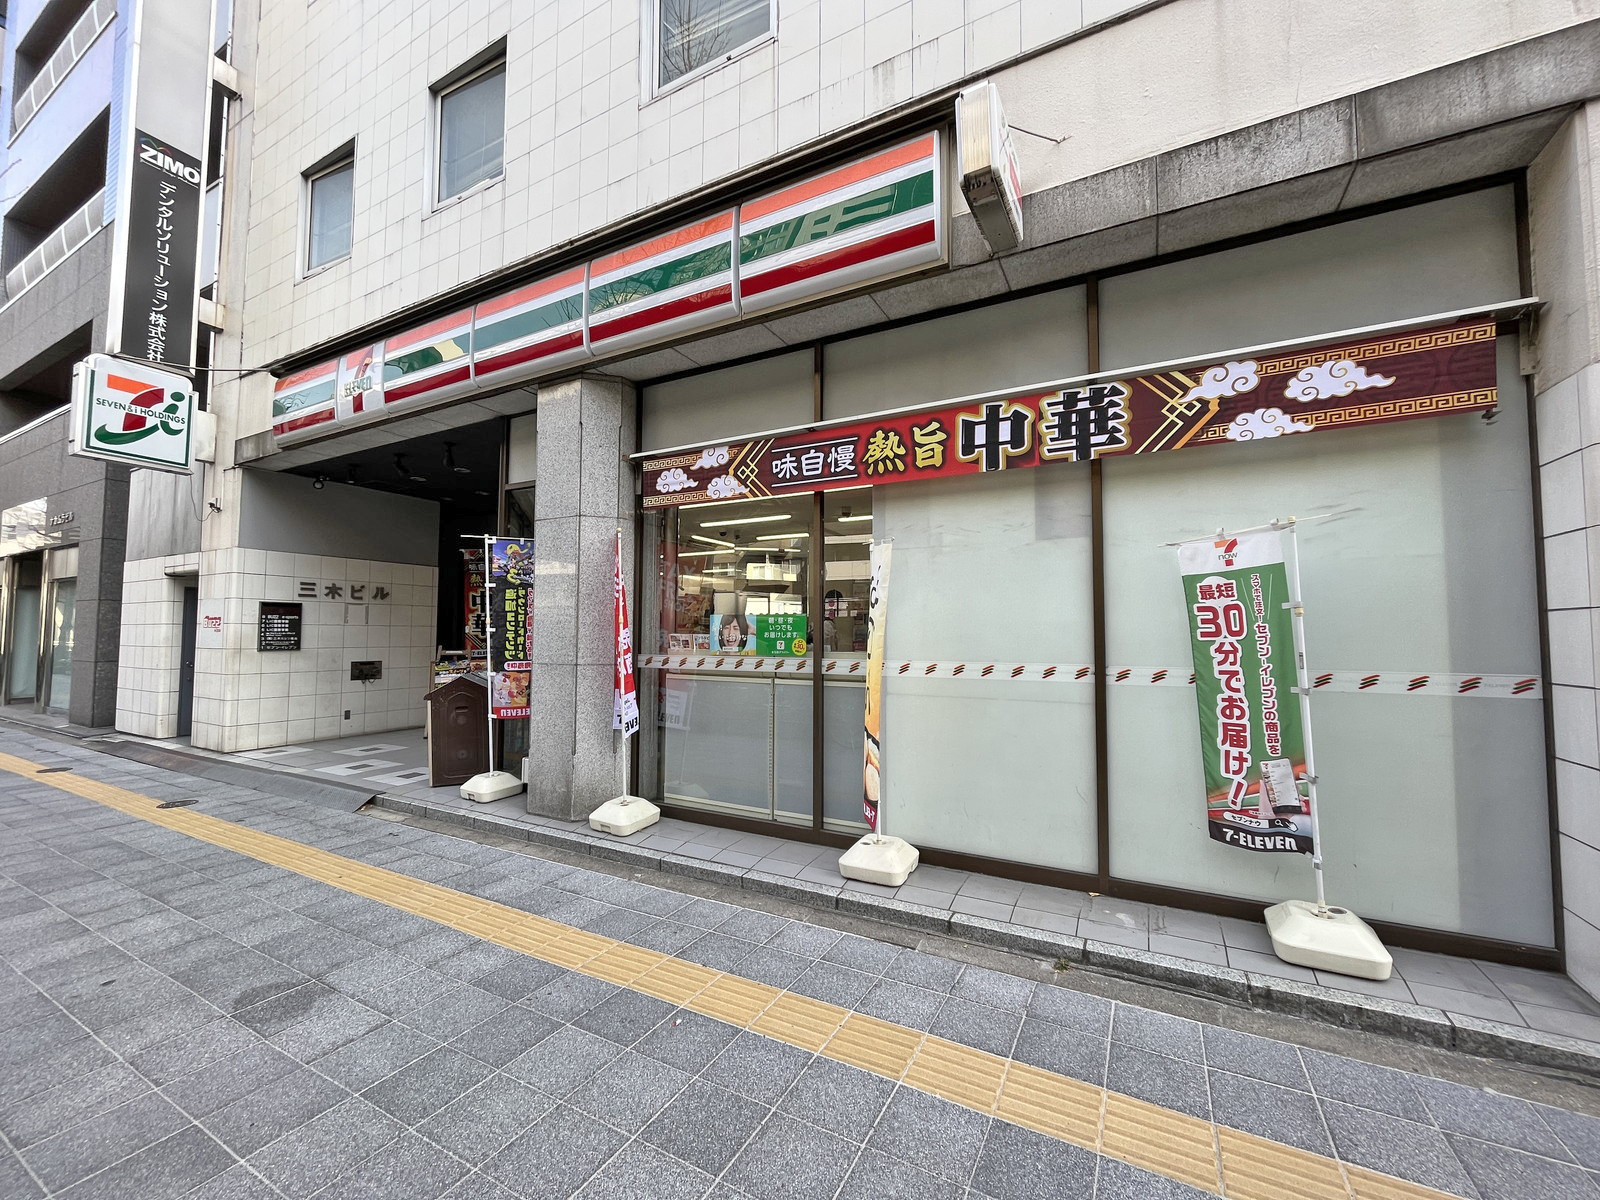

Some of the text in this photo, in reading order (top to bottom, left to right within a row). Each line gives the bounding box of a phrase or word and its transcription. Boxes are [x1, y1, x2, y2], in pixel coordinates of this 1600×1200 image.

[139, 144, 201, 184] ZIMO
[140, 408, 186, 425] HOLDINGS
[771, 444, 857, 480] 味自慢
[960, 383, 1130, 472] 中華
[298, 581, 390, 600] 三木ビル
[1199, 583, 1236, 600] 最短
[1196, 603, 1245, 638] 30
